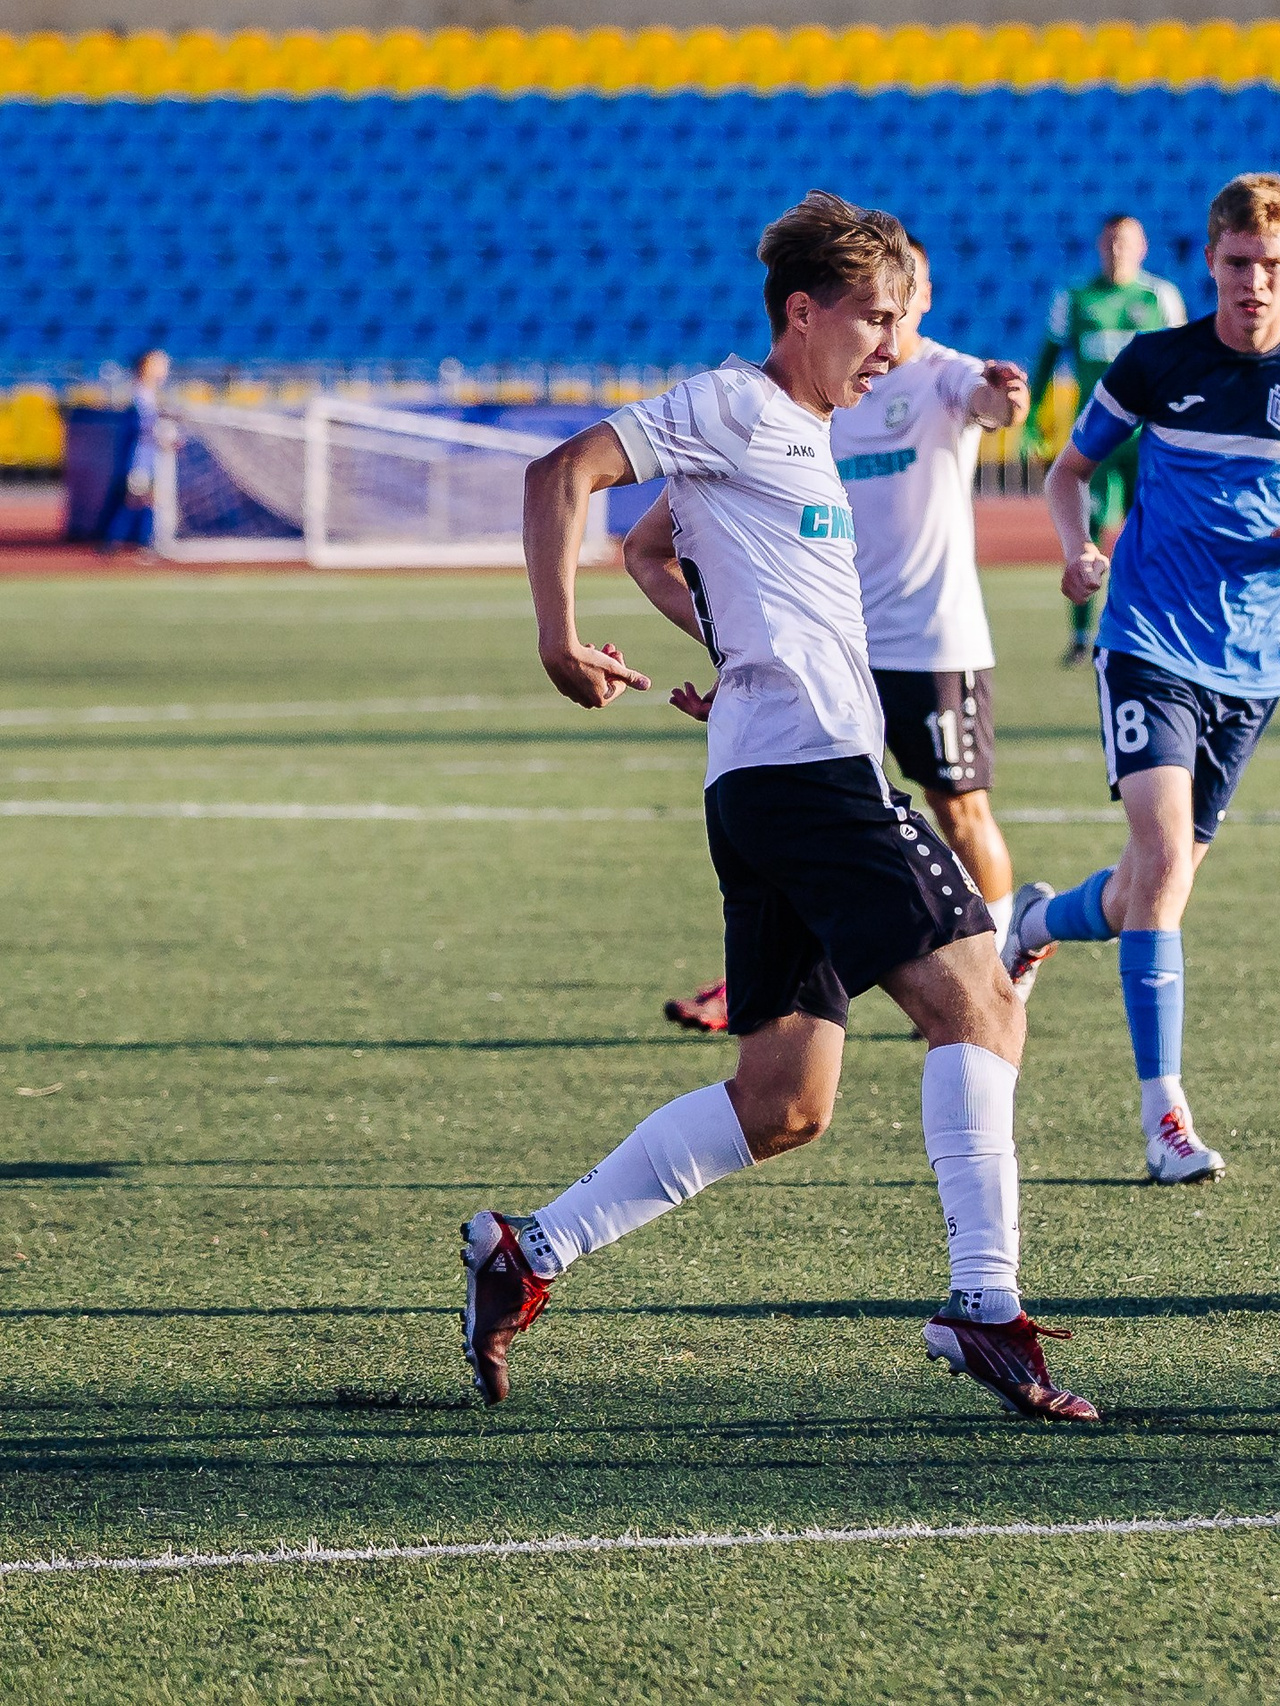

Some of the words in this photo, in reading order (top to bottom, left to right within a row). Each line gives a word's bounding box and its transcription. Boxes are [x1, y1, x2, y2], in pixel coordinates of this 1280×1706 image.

[786, 445, 815, 458] JAKO
[924, 709, 960, 764] 11
[1116, 700, 1149, 753] 8
